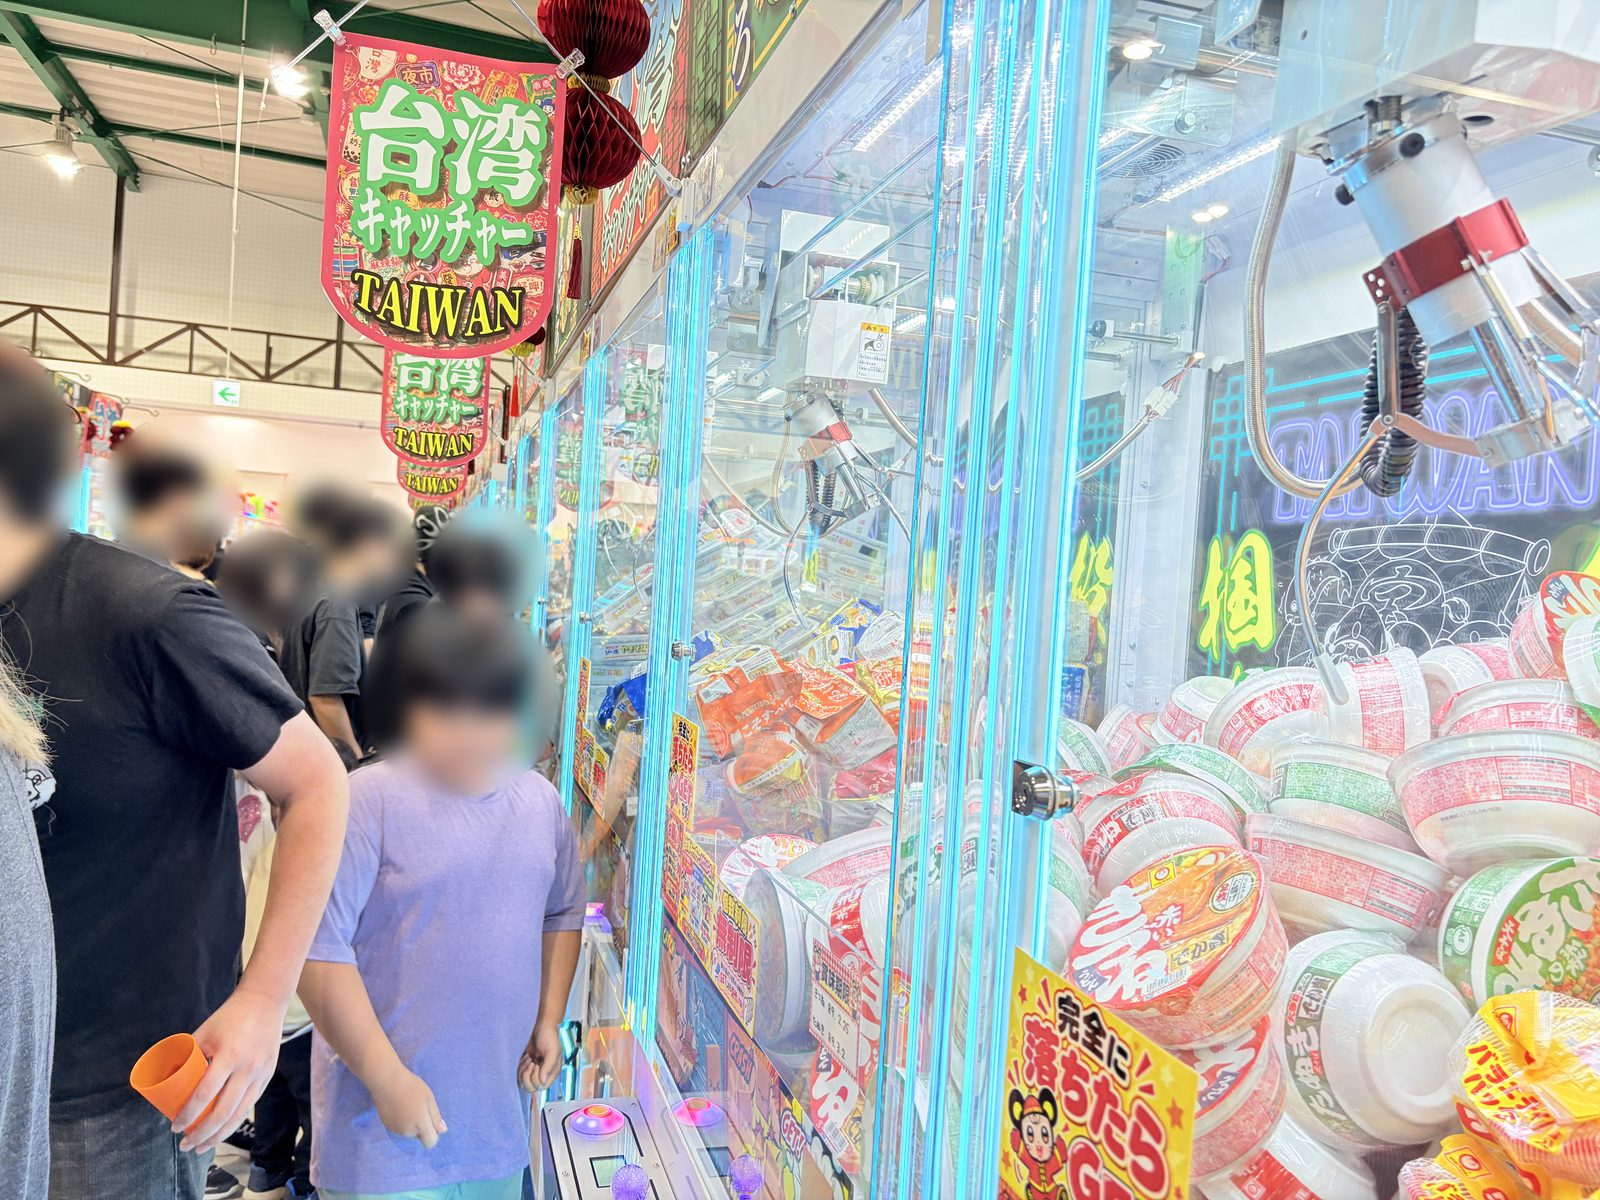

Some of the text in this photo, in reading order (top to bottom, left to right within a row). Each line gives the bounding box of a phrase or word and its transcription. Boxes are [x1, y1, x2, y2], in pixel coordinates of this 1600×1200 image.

[402, 66, 434, 84] 夜市
[360, 84, 545, 202] 台湾
[356, 188, 530, 259] キャッチャー
[354, 271, 523, 337] TAIWAN
[396, 390, 476, 424] キャッチャー
[395, 427, 474, 459] TAIWAN
[405, 472, 459, 494] TAIWAN
[1071, 881, 1169, 1004] きつね
[1548, 938, 1588, 984] 緑の
[1057, 994, 1130, 1082] 完全に
[1024, 1018, 1169, 1195] 落ちたら
[1286, 1025, 1348, 1120] たぬき
